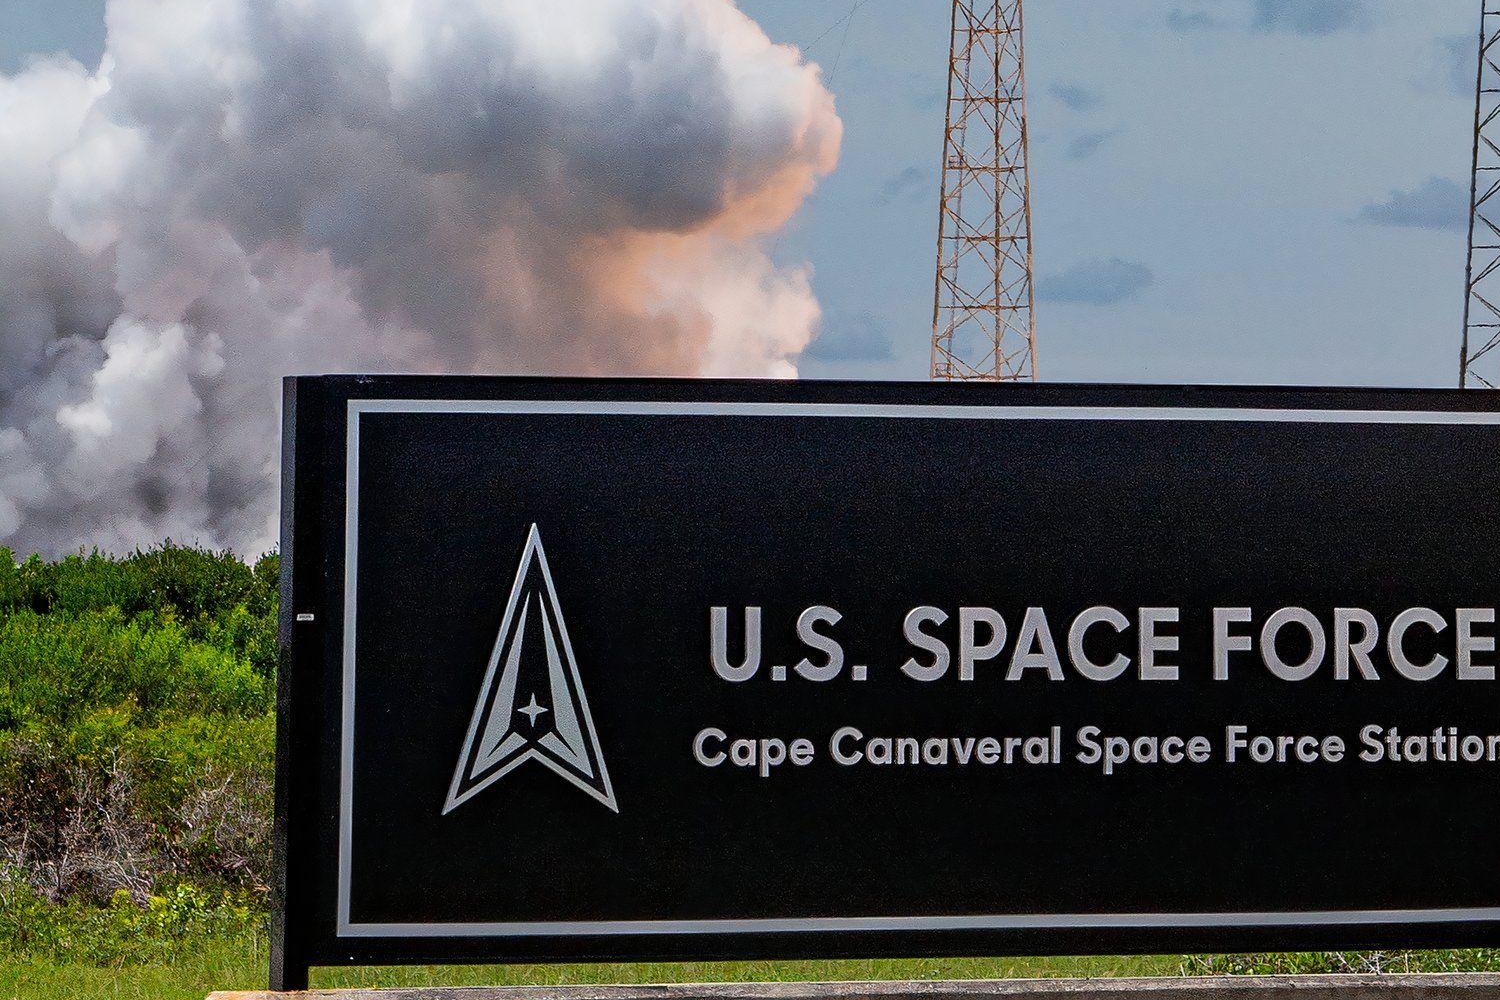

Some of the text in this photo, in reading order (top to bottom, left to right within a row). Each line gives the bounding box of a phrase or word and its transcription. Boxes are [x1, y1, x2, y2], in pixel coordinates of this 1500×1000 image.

[709, 605, 1496, 682] U.S. SPACE FORCE
[692, 727, 815, 778] Cape
[829, 725, 1061, 766] Canaveral
[1075, 725, 1212, 775] Space
[1225, 724, 1346, 764] Force
